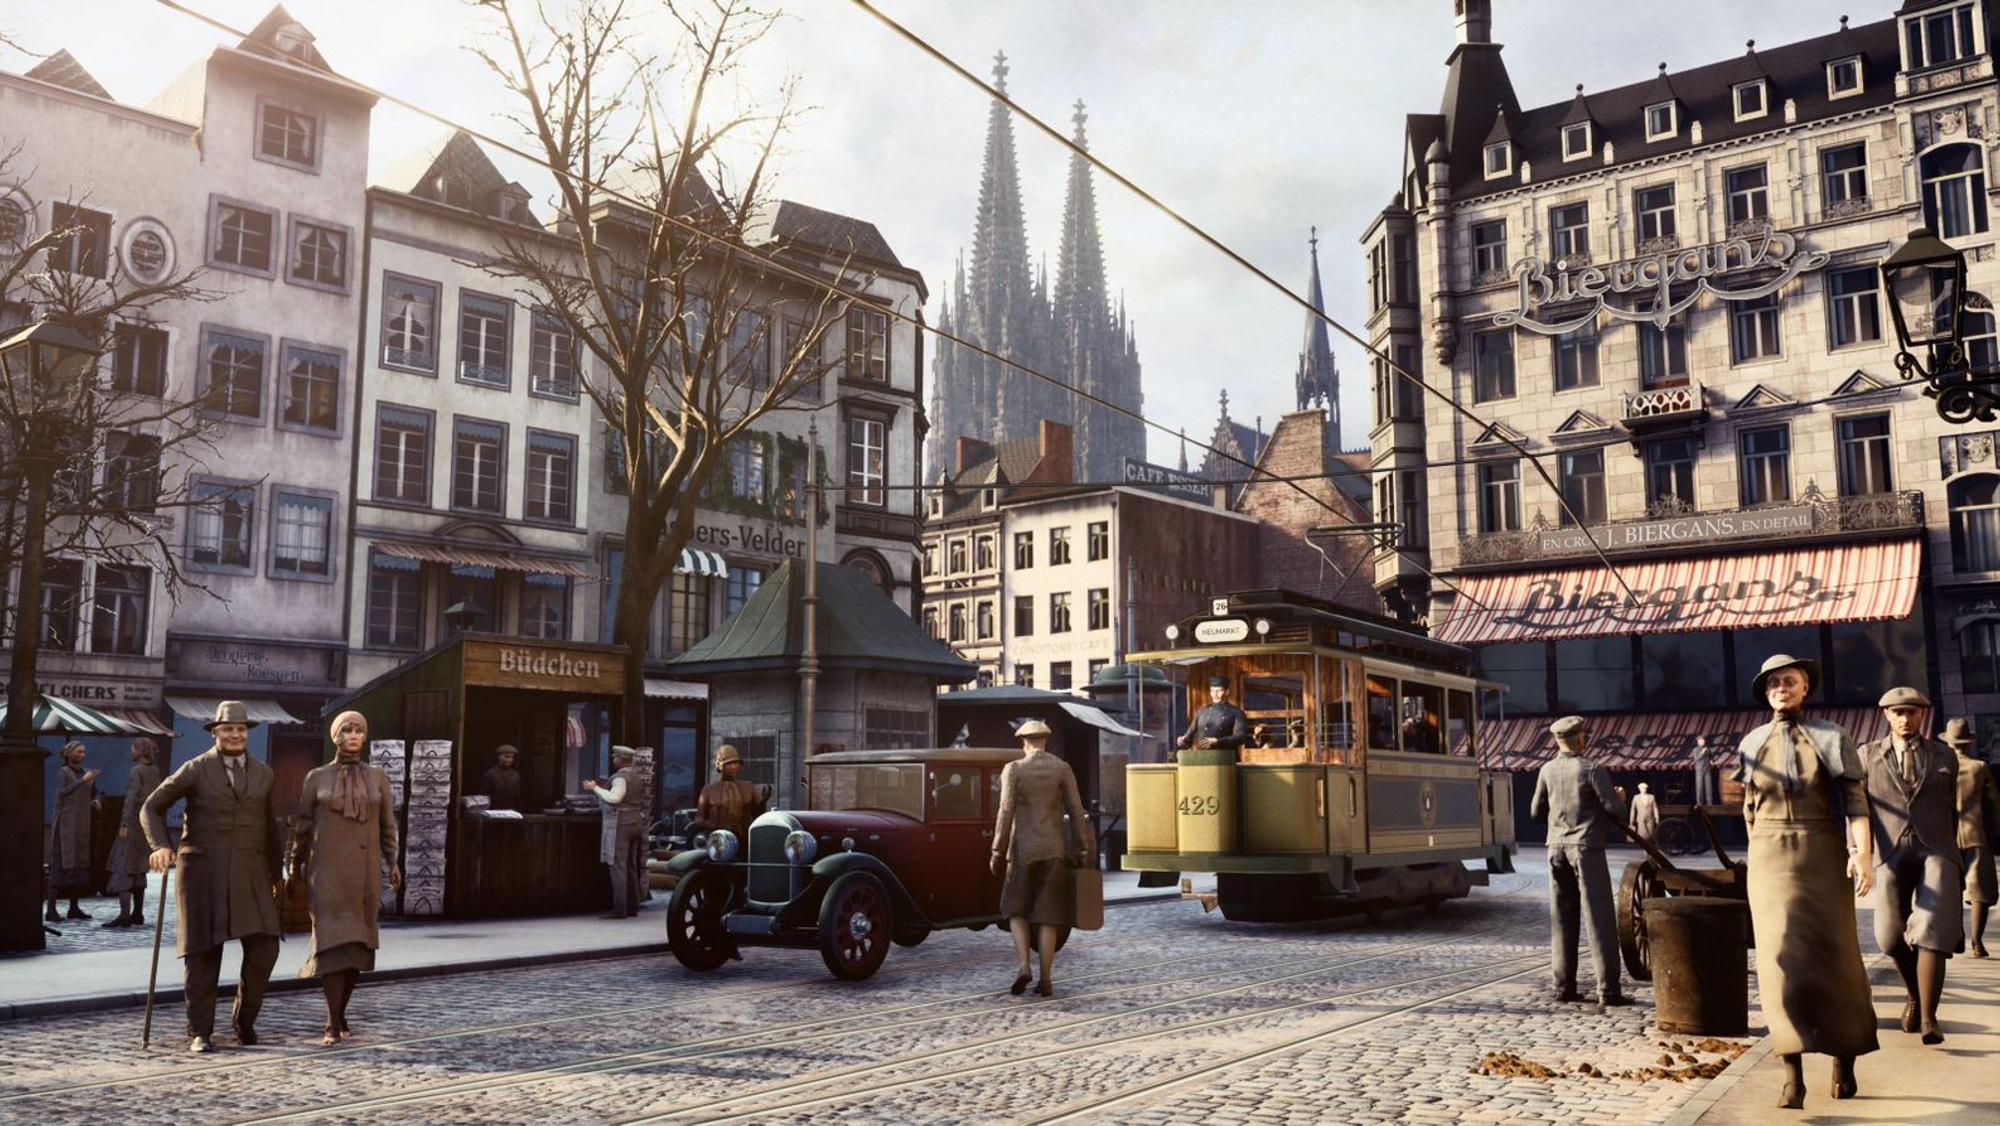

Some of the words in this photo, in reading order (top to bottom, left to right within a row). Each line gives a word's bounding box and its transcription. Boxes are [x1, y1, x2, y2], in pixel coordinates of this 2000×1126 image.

[1493, 226, 1831, 334] Biergans
[1126, 462, 1164, 483] CAFE
[1543, 539, 1561, 550] EN
[1606, 528, 1618, 549] J.
[1742, 520, 1760, 532] EN
[1763, 514, 1811, 531] DETAIL
[1215, 602, 1226, 611] 26
[500, 649, 600, 678] Büdchen
[33, 681, 118, 700] ELCHERS
[1178, 795, 1220, 816] 429
